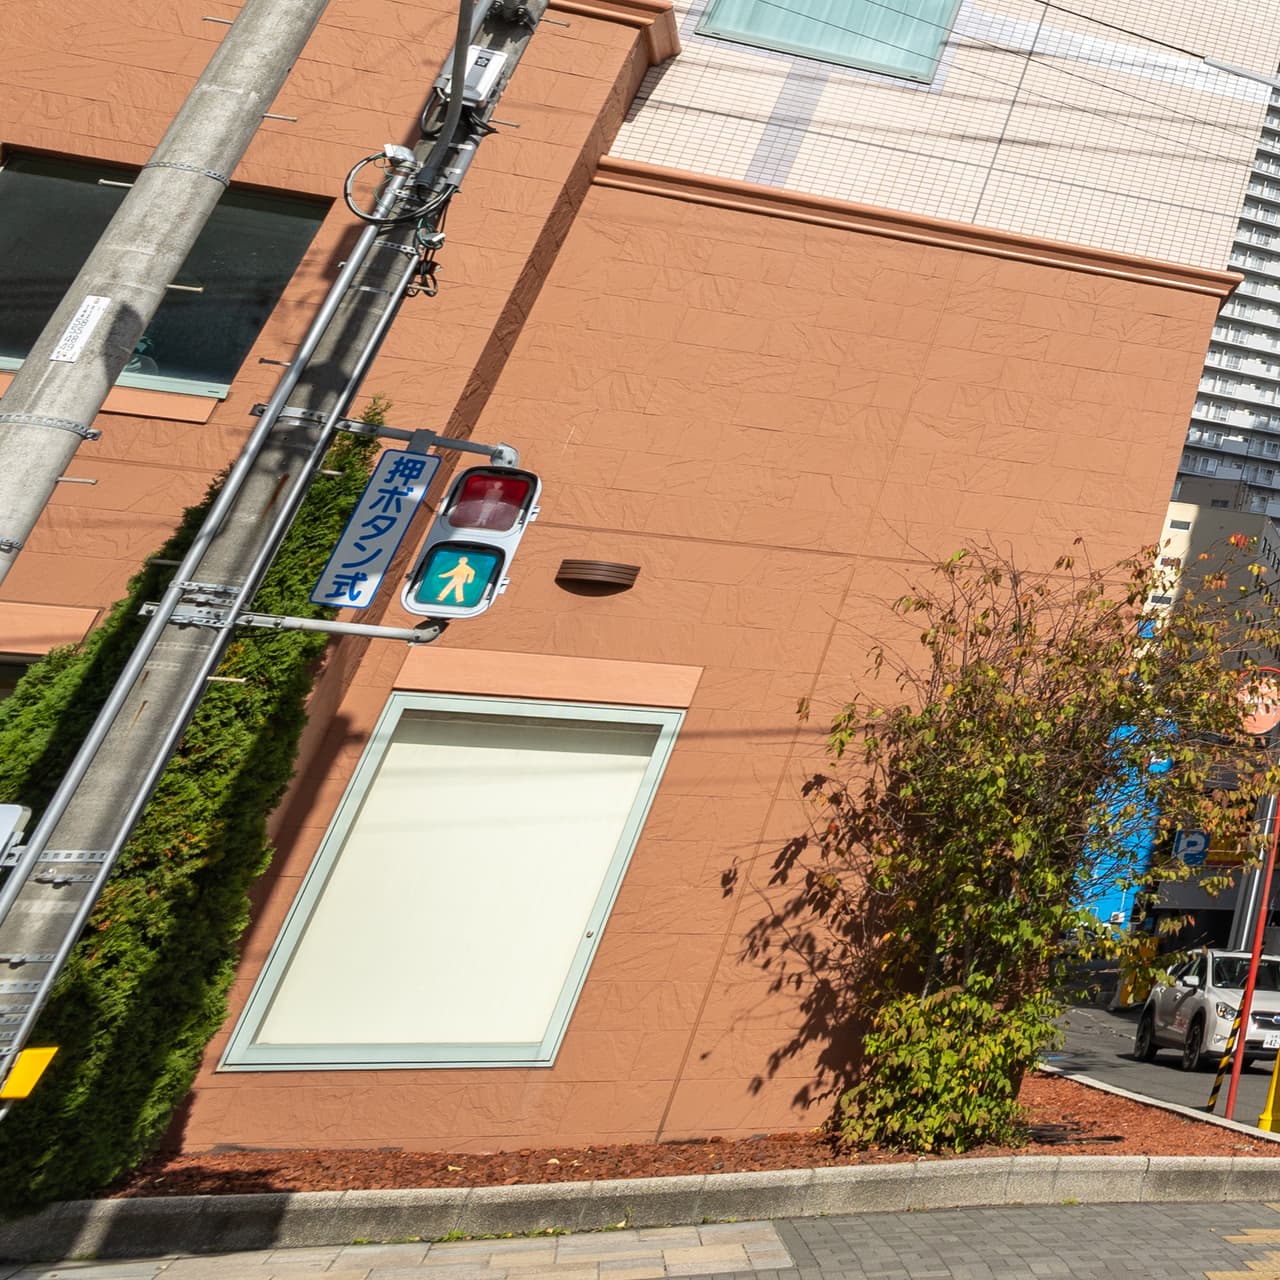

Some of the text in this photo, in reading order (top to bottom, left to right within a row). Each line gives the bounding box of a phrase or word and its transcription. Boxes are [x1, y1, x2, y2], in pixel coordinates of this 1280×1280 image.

[324, 455, 427, 602] 押ボタン式
